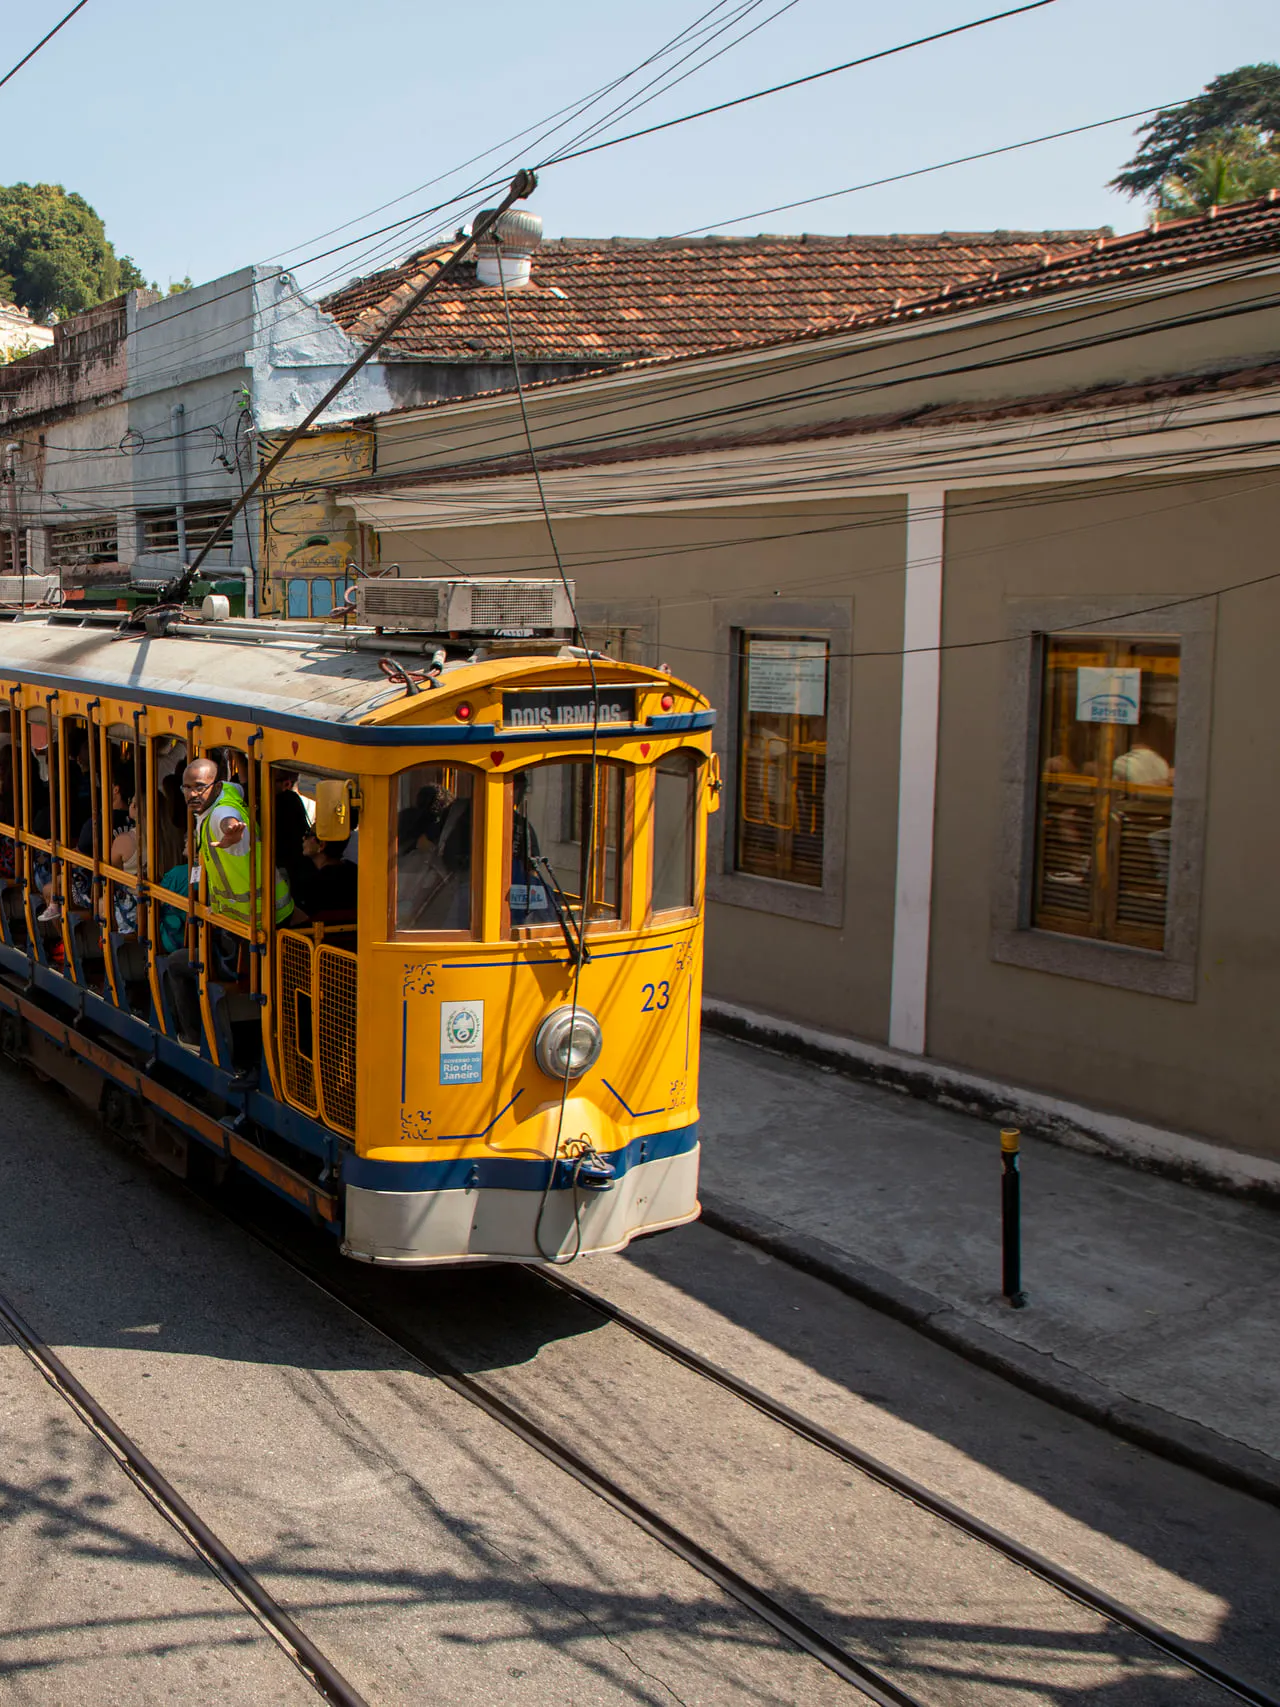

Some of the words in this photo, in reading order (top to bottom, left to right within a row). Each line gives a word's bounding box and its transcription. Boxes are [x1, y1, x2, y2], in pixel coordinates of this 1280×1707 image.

[510, 707, 552, 726] DOIS
[640, 980, 669, 1012] 23
[443, 1063, 459, 1071] Rio
[461, 1062, 473, 1070] de
[443, 1071, 479, 1080] Janeiro
